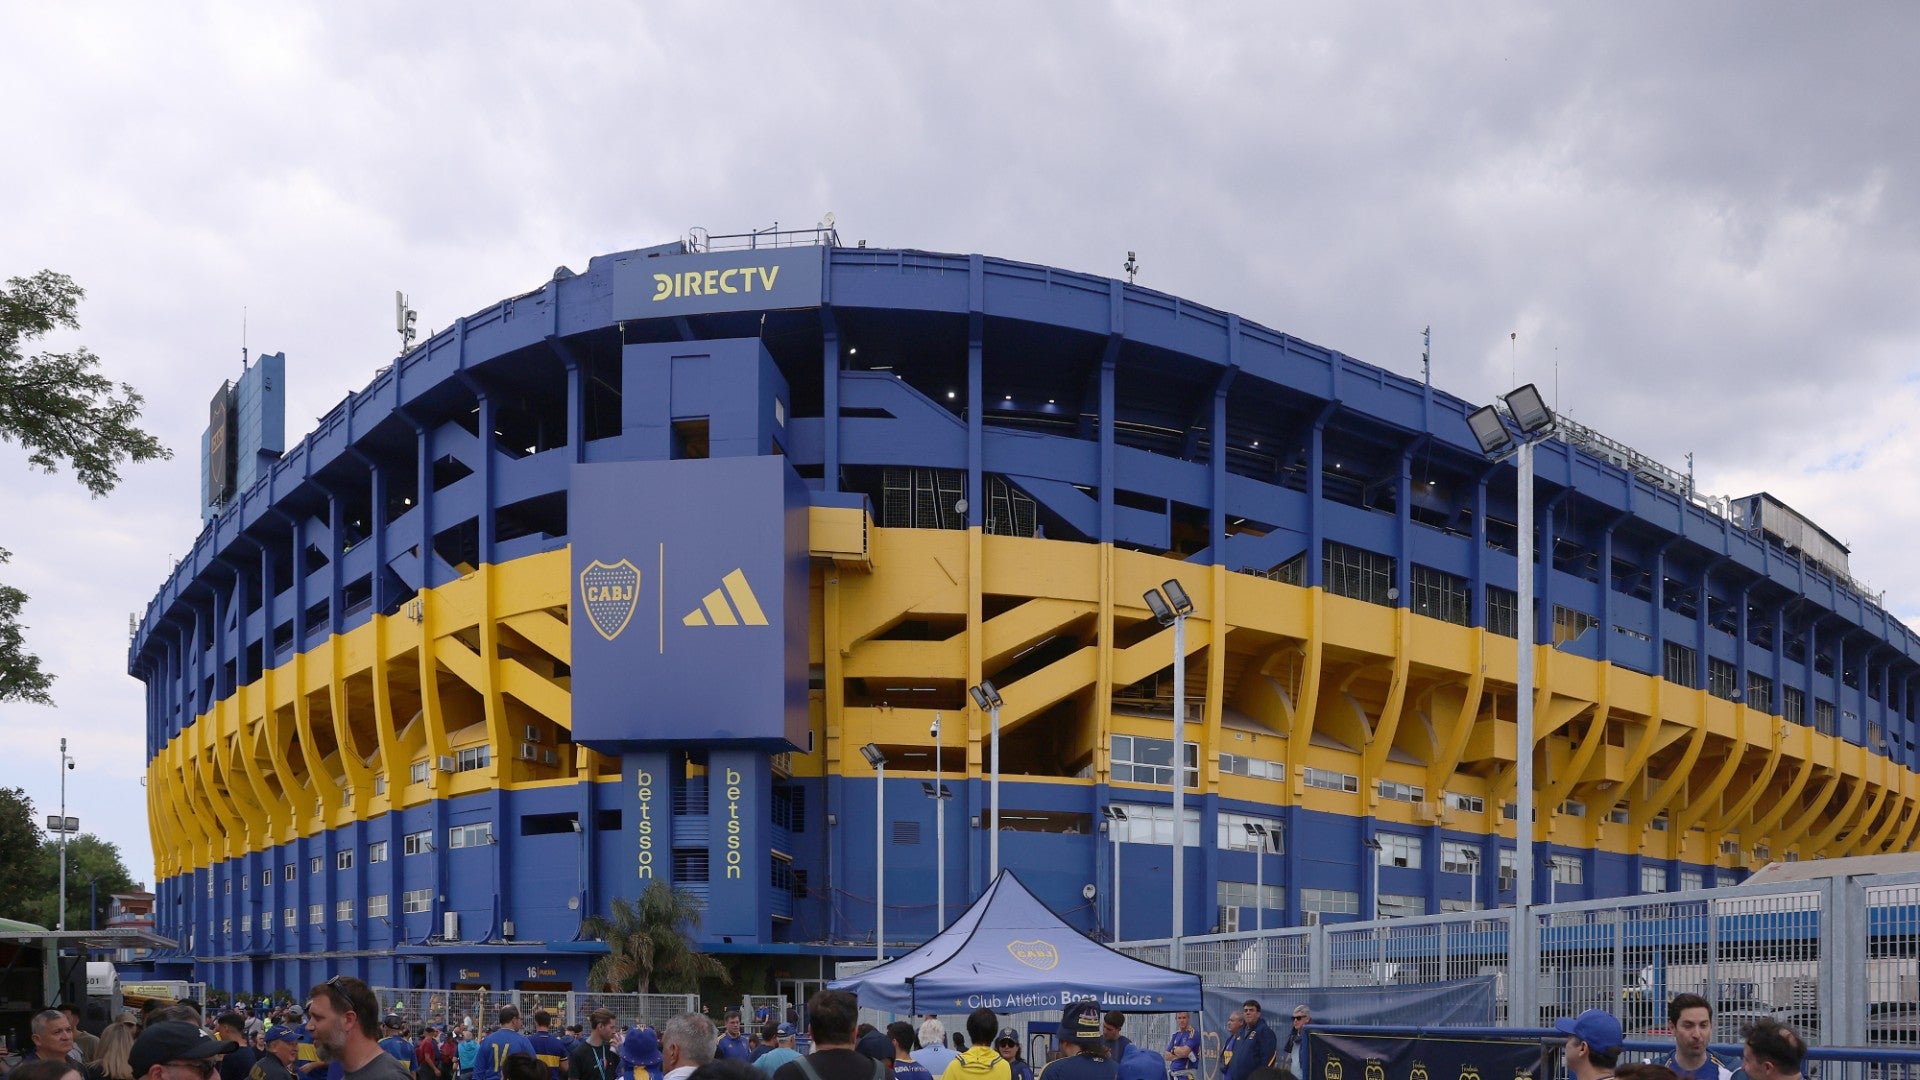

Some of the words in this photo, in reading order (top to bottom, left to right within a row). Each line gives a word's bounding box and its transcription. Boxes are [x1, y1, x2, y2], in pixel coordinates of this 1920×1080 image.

[652, 266, 780, 301] DIRECTV
[588, 585, 633, 602] CABJ
[638, 769, 653, 879] betsson
[726, 768, 741, 879] betsson
[459, 968, 467, 980] 15
[526, 966, 537, 978] 16
[967, 994, 1001, 1009] Club
[1005, 991, 1057, 1007] Atlético
[1102, 992, 1152, 1006] Juniors
